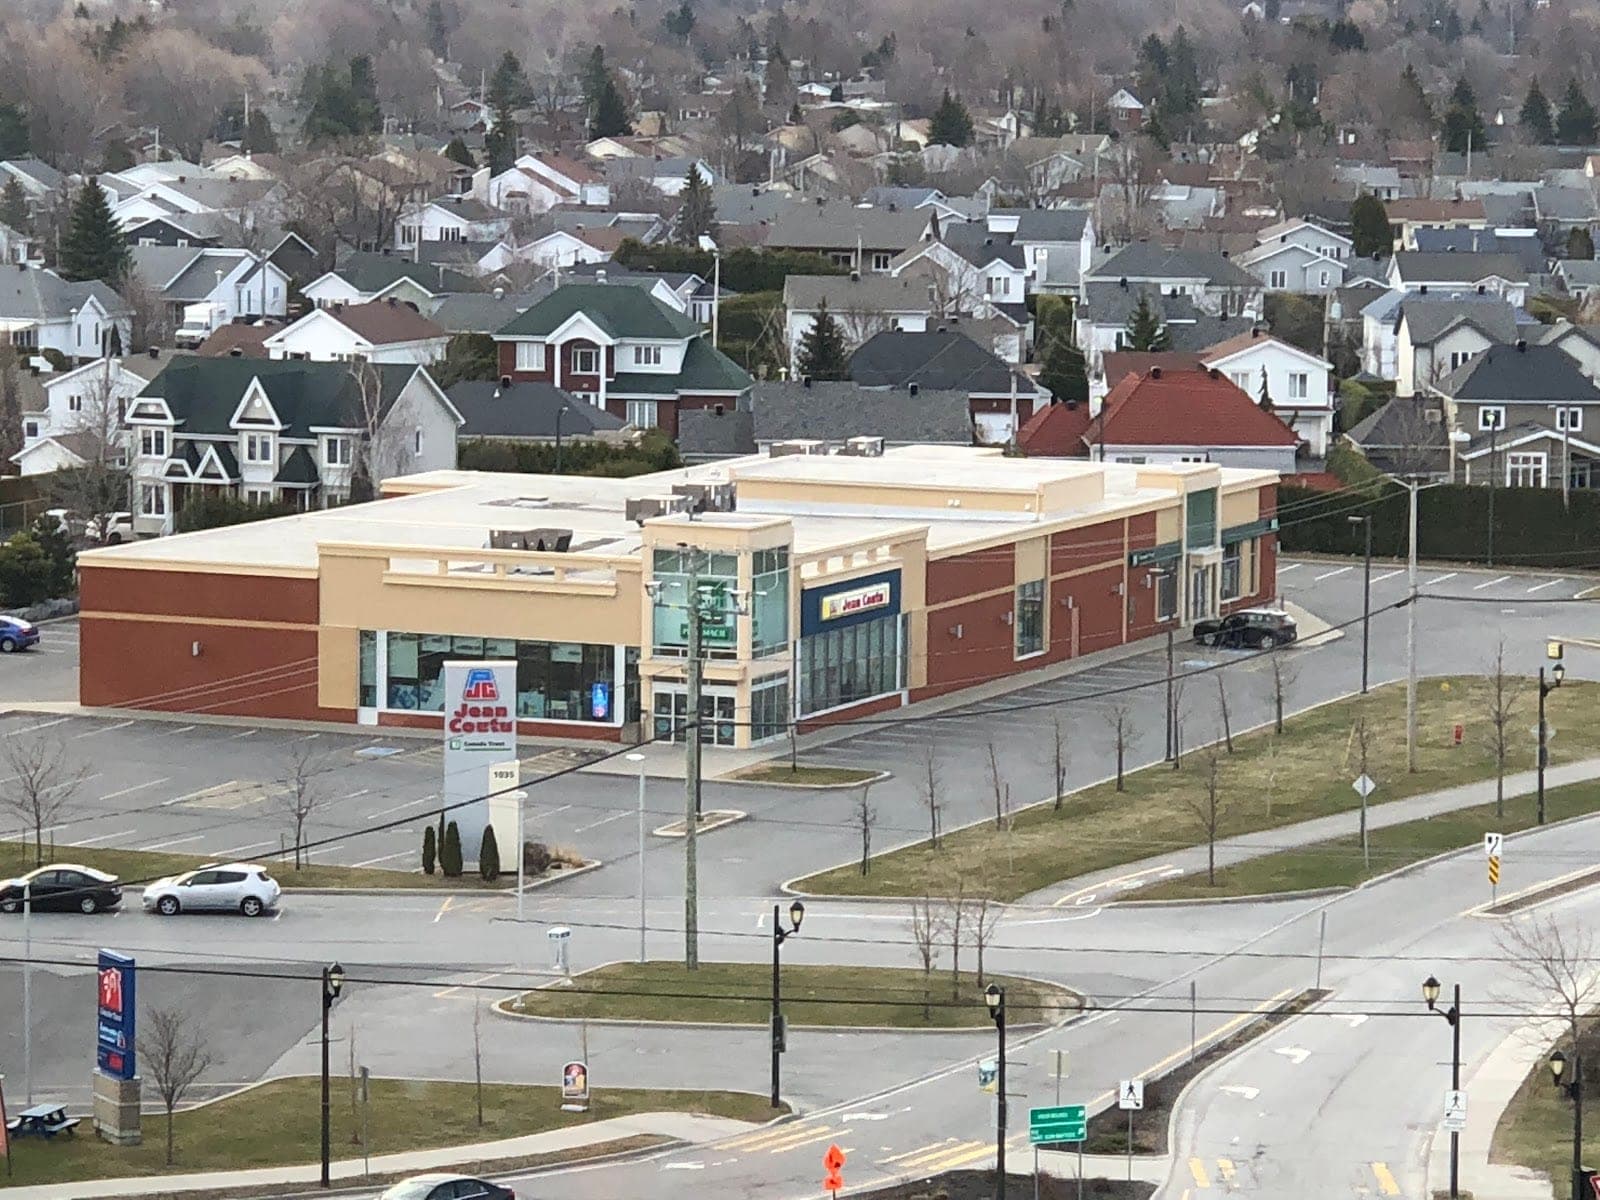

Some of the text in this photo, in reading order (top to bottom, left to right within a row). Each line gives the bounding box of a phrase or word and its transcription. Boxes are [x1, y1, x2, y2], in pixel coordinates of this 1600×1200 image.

[466, 682, 496, 698] JC
[454, 703, 508, 718] Jean
[494, 771, 515, 779] 1035
